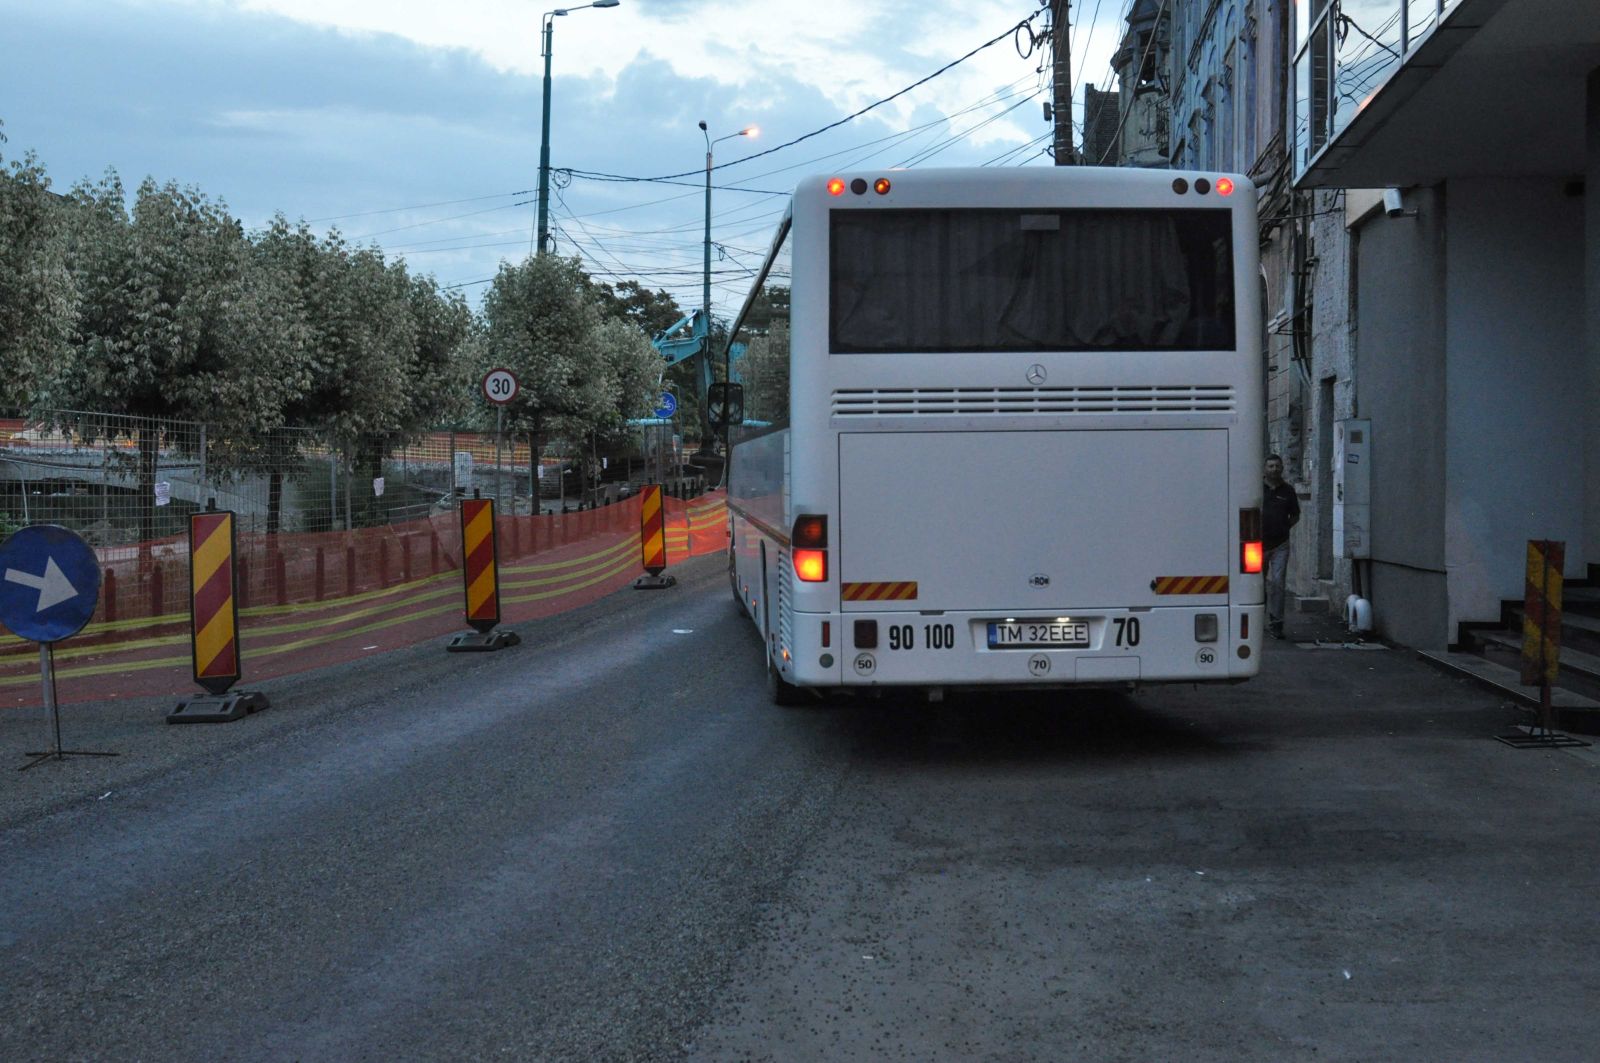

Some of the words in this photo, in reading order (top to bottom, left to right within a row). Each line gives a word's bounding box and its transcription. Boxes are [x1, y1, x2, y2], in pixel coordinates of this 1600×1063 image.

[492, 378, 510, 395] 30
[889, 625, 914, 650] 90
[924, 623, 954, 649] 100
[998, 625, 1022, 641] TM
[1029, 624, 1087, 641] 32EEE
[1113, 617, 1140, 646] 70
[858, 659, 872, 669] 50
[1033, 660, 1047, 669] 70
[1200, 653, 1214, 664] 90
